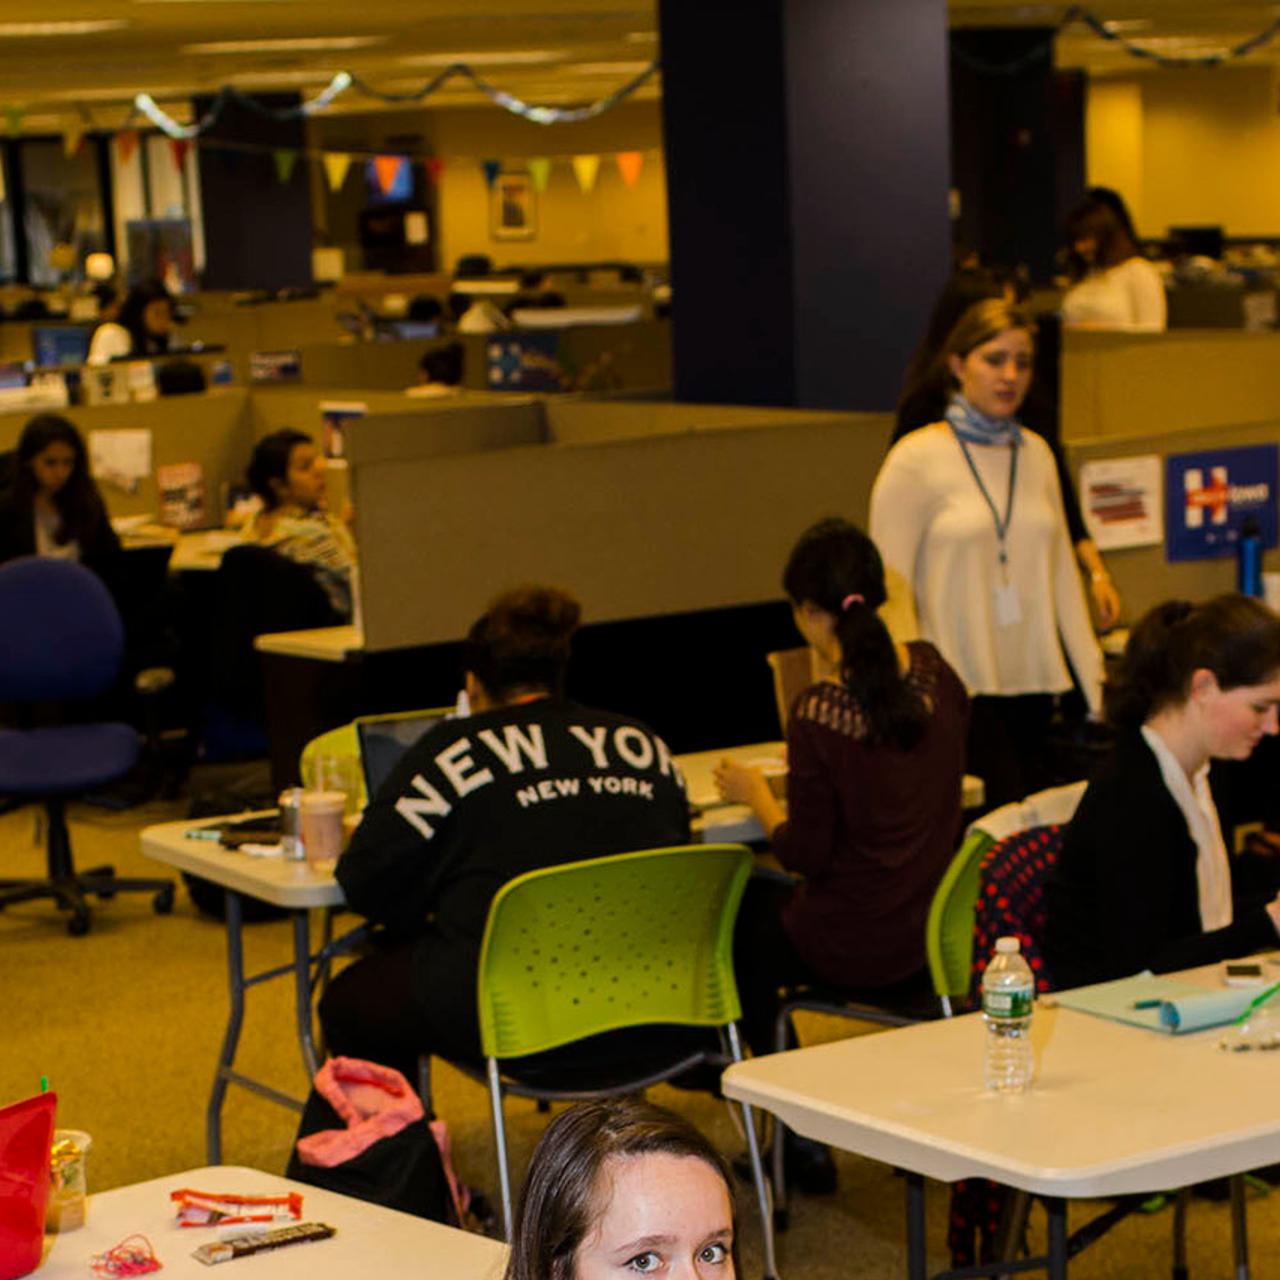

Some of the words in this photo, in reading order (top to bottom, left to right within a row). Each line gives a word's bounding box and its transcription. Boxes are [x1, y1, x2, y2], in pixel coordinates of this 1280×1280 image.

[394, 723, 550, 841] NEW
[515, 778, 581, 808] NEW
[587, 776, 656, 800] YORK
